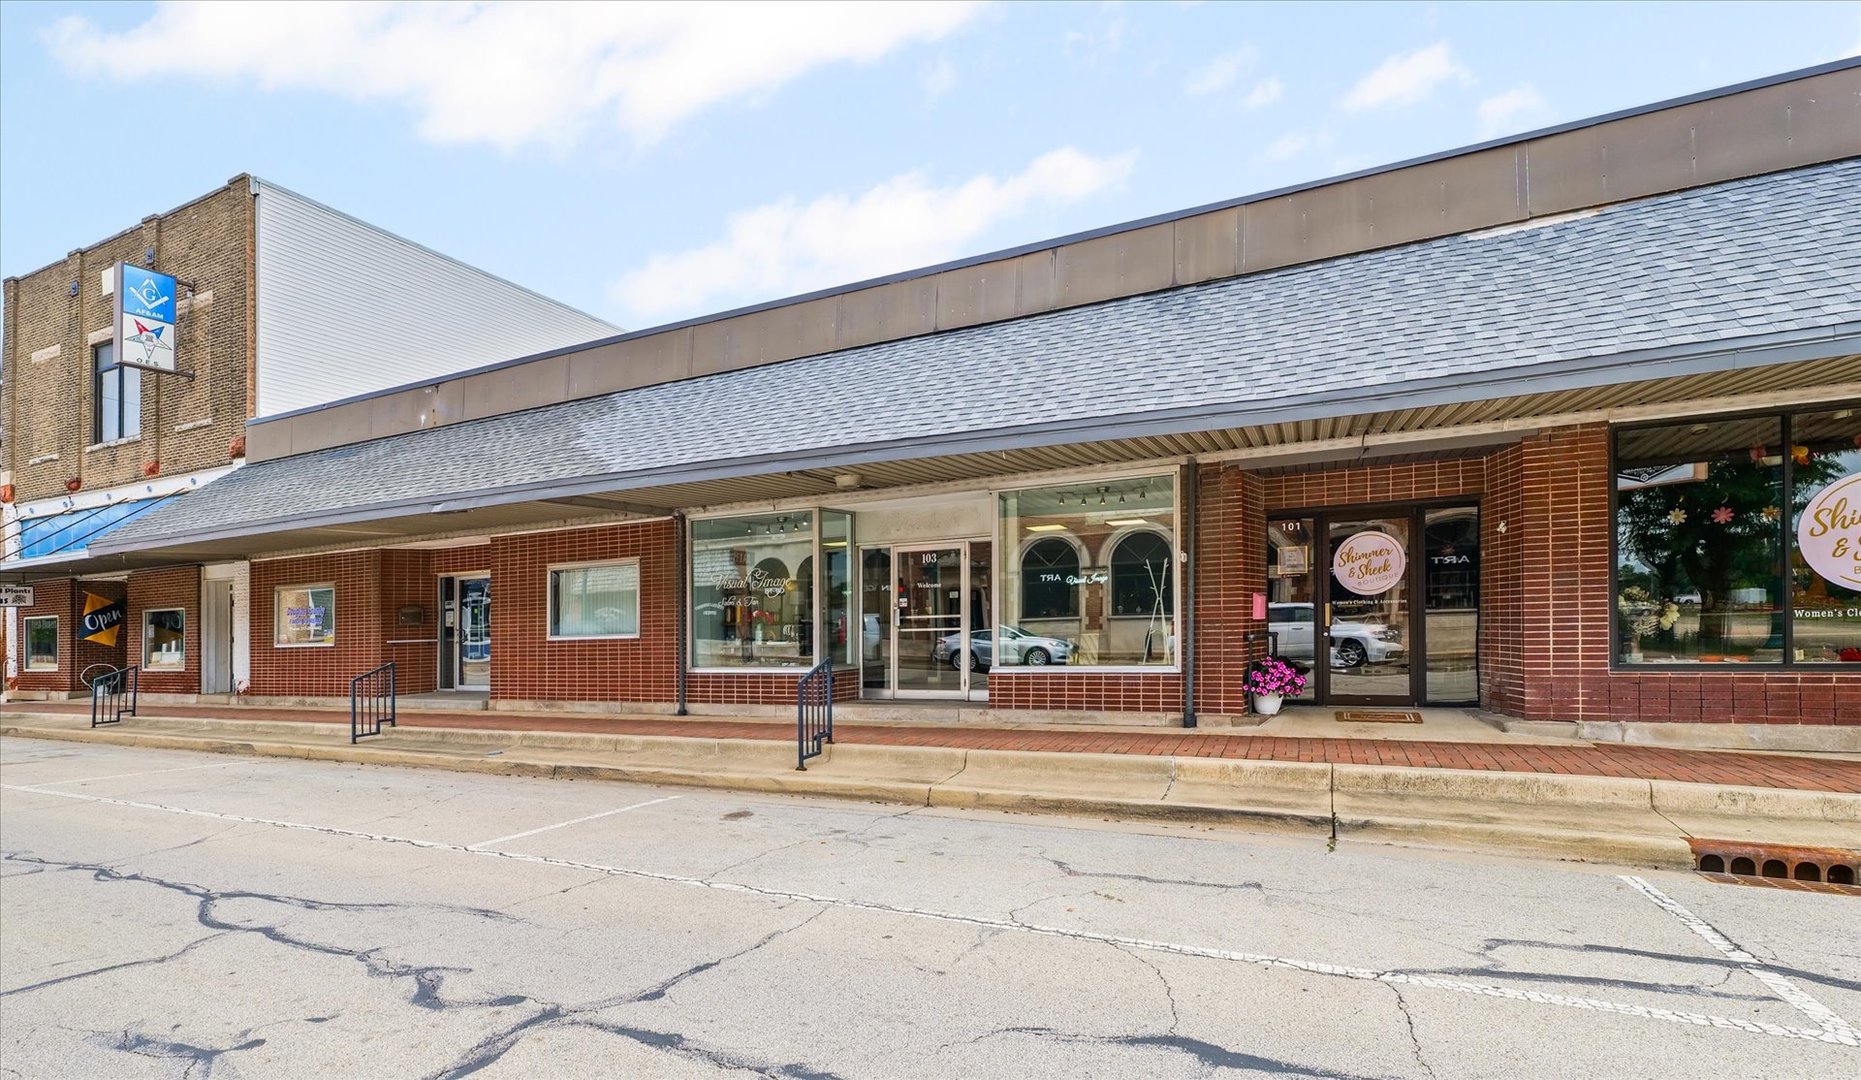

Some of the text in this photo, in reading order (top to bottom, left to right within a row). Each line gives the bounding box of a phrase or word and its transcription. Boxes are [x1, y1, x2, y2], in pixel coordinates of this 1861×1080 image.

[143, 288, 156, 301] G
[1282, 522, 1301, 531] 101
[1808, 497, 1861, 537] Shi
[1338, 546, 1393, 568] Shimmer
[1831, 537, 1850, 558] &
[922, 552, 937, 564] 103
[1348, 559, 1393, 580] & Sheek
[1357, 572, 1400, 586] BOUTIQUE
[711, 568, 792, 598] Visual Image
[85, 610, 122, 630] Open
[1794, 608, 1843, 618] Women's
